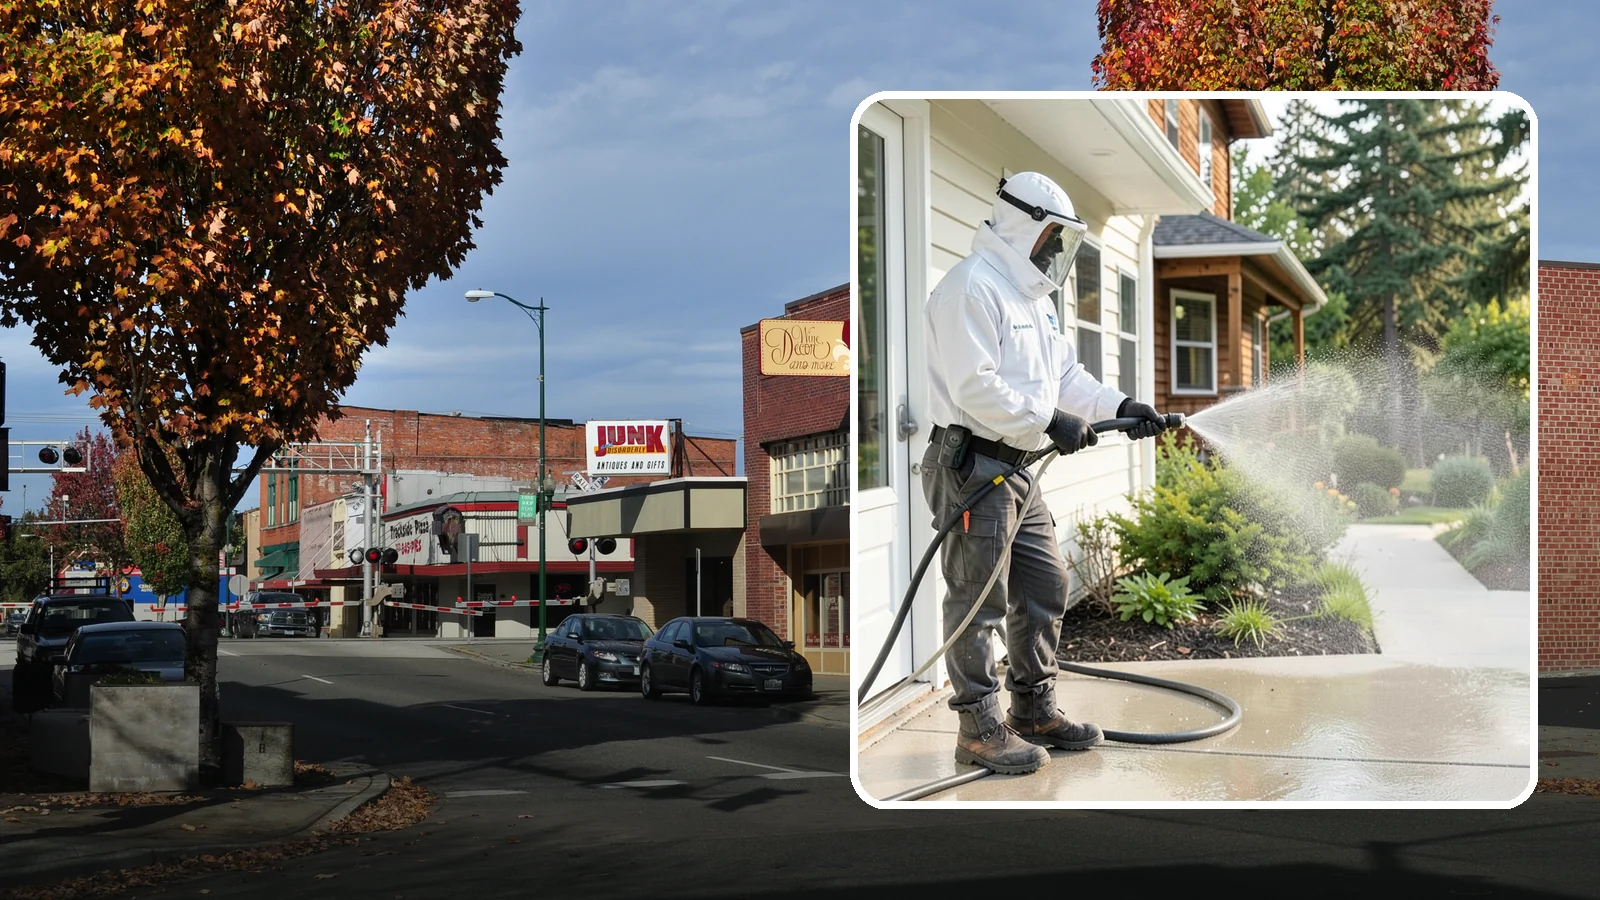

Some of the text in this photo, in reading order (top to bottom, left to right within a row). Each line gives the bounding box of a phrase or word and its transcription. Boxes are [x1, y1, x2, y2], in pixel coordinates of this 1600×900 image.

[595, 425, 665, 457] JUNK
[607, 446, 646, 454] DISORDERLY
[597, 460, 666, 470] ANTIQUES AND GIFTS
[390, 519, 429, 540] Trackside Pizza
